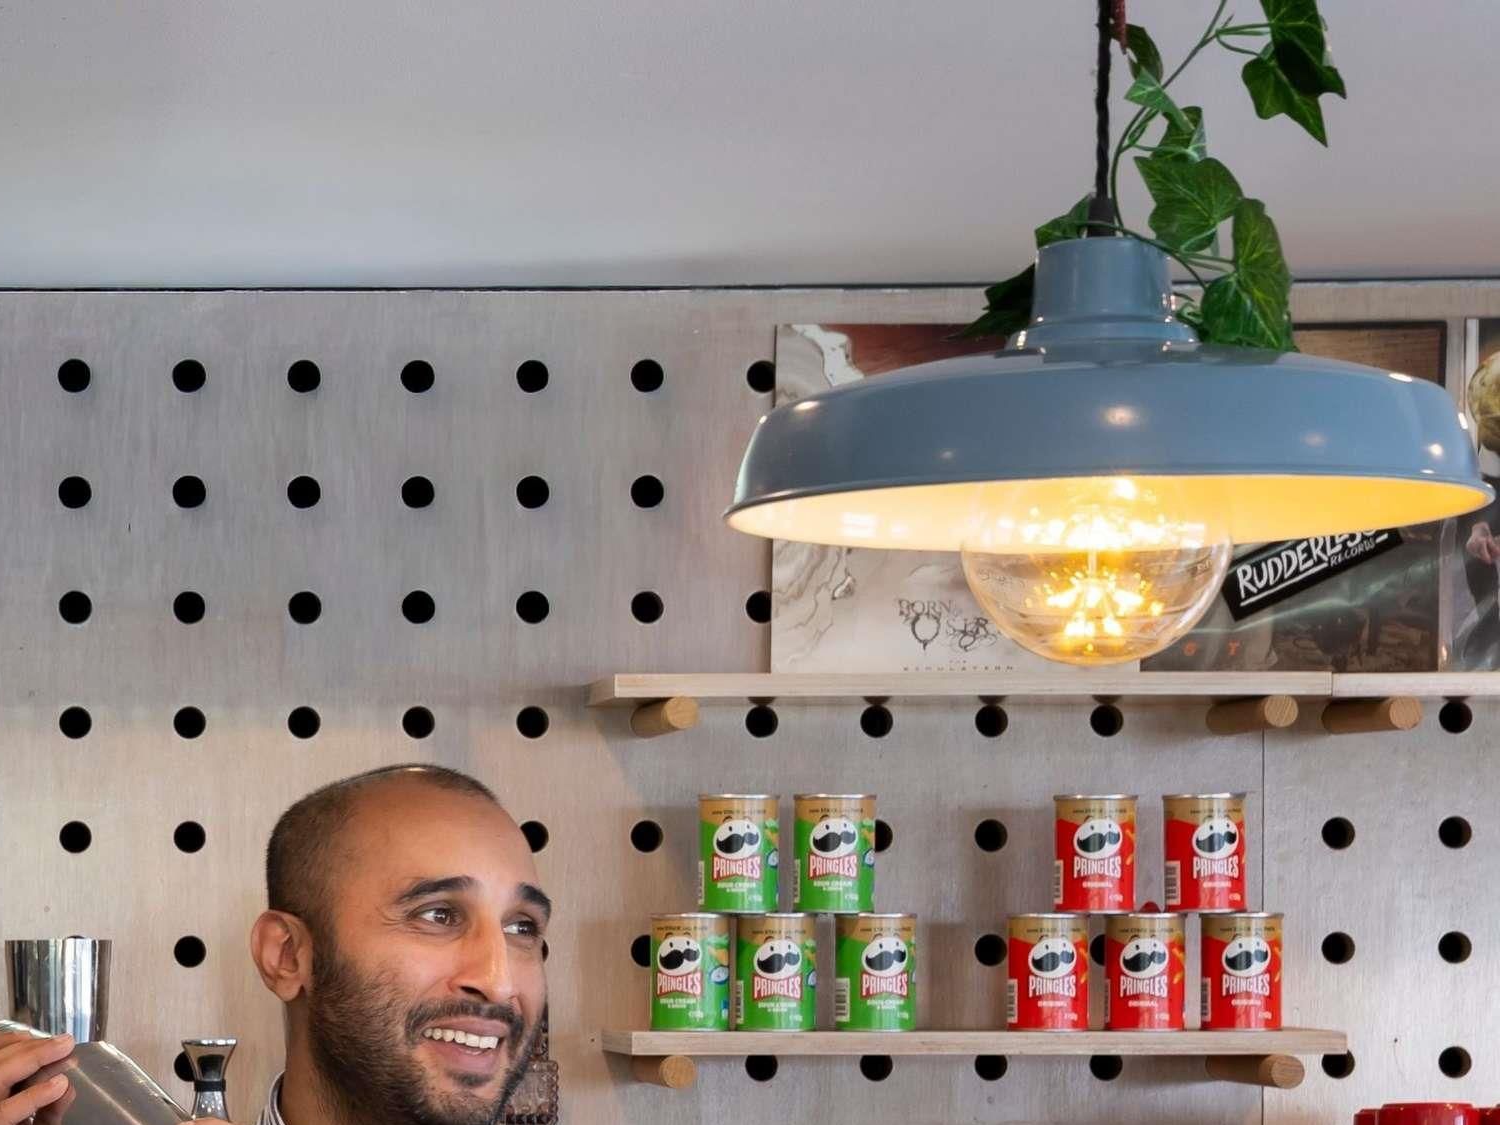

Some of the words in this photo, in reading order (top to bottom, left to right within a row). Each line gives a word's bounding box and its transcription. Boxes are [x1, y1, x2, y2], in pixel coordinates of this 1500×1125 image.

[1236, 530, 1377, 599] RUDDERLES
[1330, 539, 1377, 568] RECORDS
[712, 854, 761, 880] PRINGLES
[808, 853, 858, 879] PRINGLES
[1073, 855, 1122, 879] PRINGLES
[1192, 855, 1239, 879] PRINGLES
[656, 971, 701, 996] PRINGLES
[753, 975, 802, 1000] PRINGLES
[861, 972, 908, 998] PRINGLES
[1028, 974, 1076, 998] PRINGLES
[1119, 974, 1168, 998] PRINGLES
[1221, 973, 1270, 996] PRINGLES
